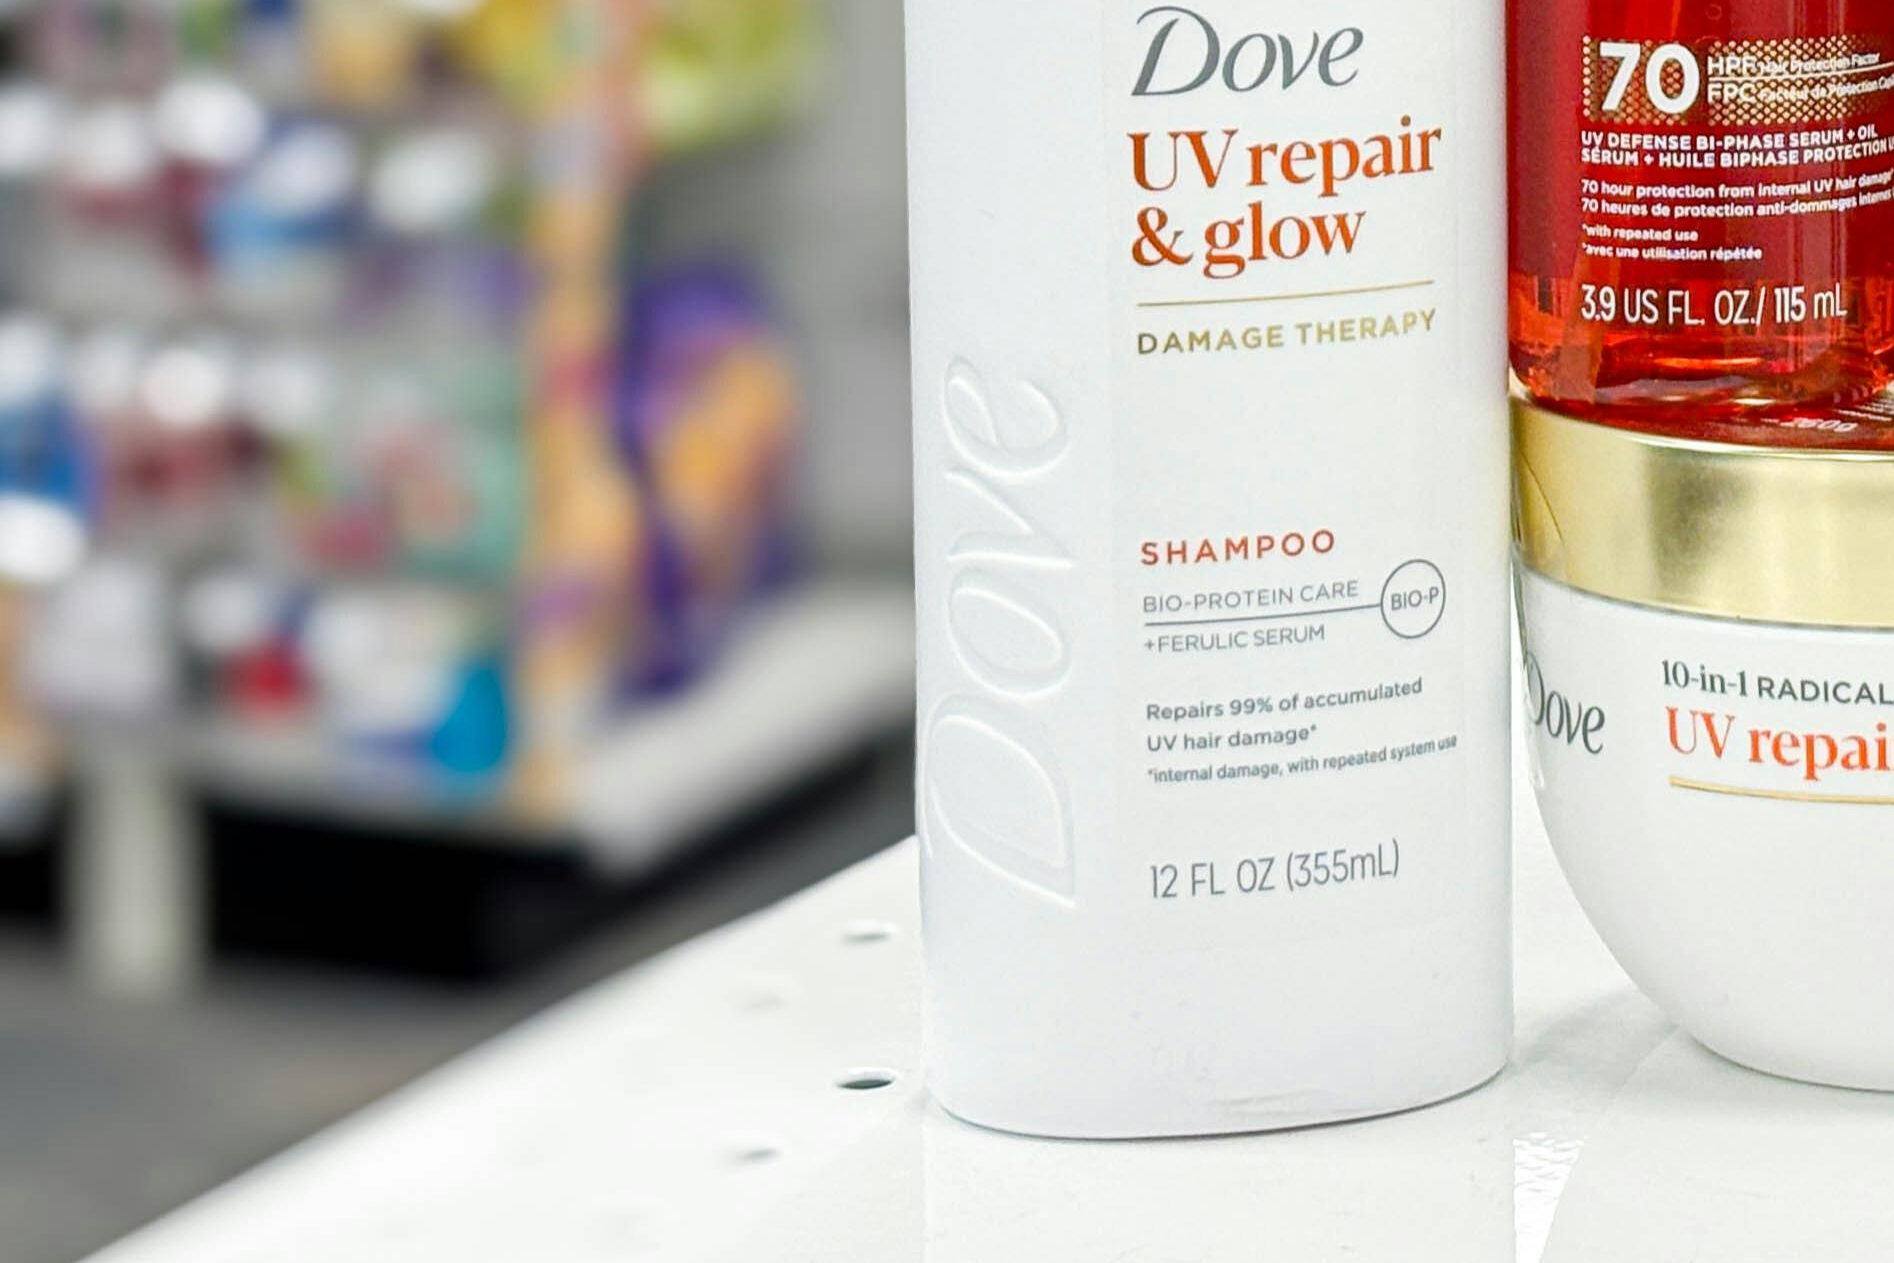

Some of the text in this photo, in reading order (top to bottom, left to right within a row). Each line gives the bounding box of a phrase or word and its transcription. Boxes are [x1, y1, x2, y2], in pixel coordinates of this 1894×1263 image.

[1131, 5, 1364, 97] Dove
[1599, 40, 1701, 115] 70
[1127, 114, 1442, 199] UV repair
[1581, 130, 1604, 147] UV
[1607, 132, 1692, 151] DEFENSE
[1696, 133, 1785, 151] BI-PHASE
[1789, 128, 1844, 147] SERUM
[1857, 124, 1879, 140] OIL
[1581, 146, 1639, 166] SÉRUM
[1658, 152, 1715, 168] HUILE
[1720, 150, 1800, 168] BIPHASE
[1803, 137, 1888, 164] PROTECTION
[1581, 175, 1857, 199] 70 hour protection from internal UV hair
[1581, 197, 1599, 213] 70
[1601, 199, 1648, 216] heures
[1651, 202, 1671, 217] de
[1674, 202, 1754, 219] protection
[1131, 200, 1368, 280] & glow
[1675, 229, 1699, 242] use
[1580, 282, 1849, 326] 3.9 US FL. 115 mL
[1137, 307, 1437, 356] DAMAGE THERAPY
[1140, 528, 1336, 567] SHAMPOO
[1142, 579, 1360, 614] BIO-PROTEIN CARE
[1390, 585, 1440, 612] BIO-P
[1253, 624, 1326, 648] SERUM
[1661, 658, 1748, 698] 10-in-1
[1146, 676, 1423, 723] Repairs 99% of accumulated
[1147, 734, 1178, 752] UV
[1183, 731, 1223, 750] hair
[1666, 705, 1736, 760] UV
[1216, 761, 1283, 782] damage,
[1287, 755, 1319, 774] with
[1322, 746, 1388, 772] repeated
[1390, 739, 1436, 763] system
[1149, 837, 1401, 899] 12 FL OZ (355mL)
